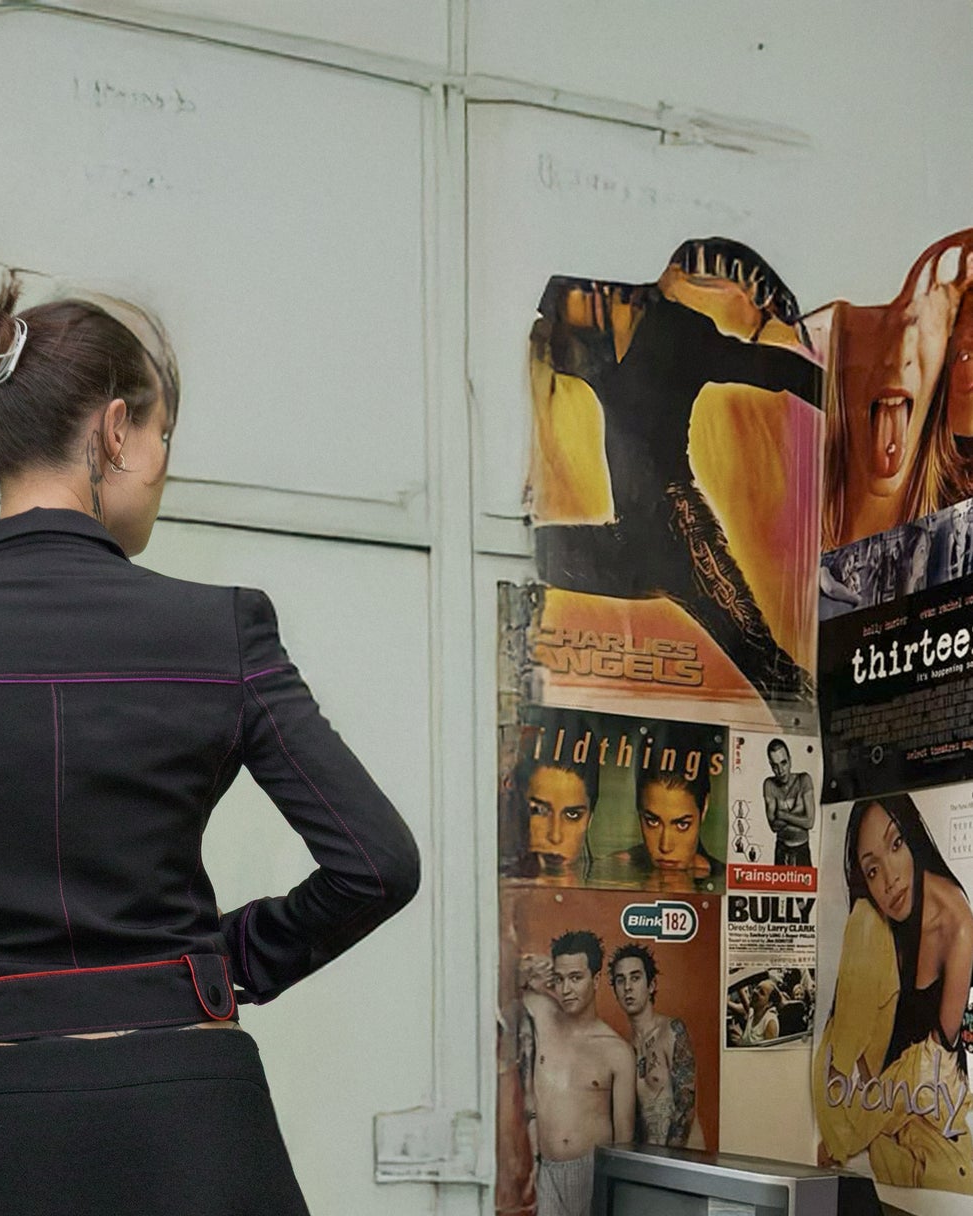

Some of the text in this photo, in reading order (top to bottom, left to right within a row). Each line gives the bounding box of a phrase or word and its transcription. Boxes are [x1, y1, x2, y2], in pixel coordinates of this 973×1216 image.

[534, 645, 704, 687] ANGELS
[852, 626, 973, 684] thirtee
[931, 664, 964, 679] happening
[533, 726, 725, 782] ildthings
[733, 867, 812, 887] Trainspotting
[628, 912, 687, 931] Blink 182
[728, 895, 816, 924] BULLY
[728, 923, 816, 933] Directed by Larry CLARK
[824, 1042, 969, 1140] brandy
